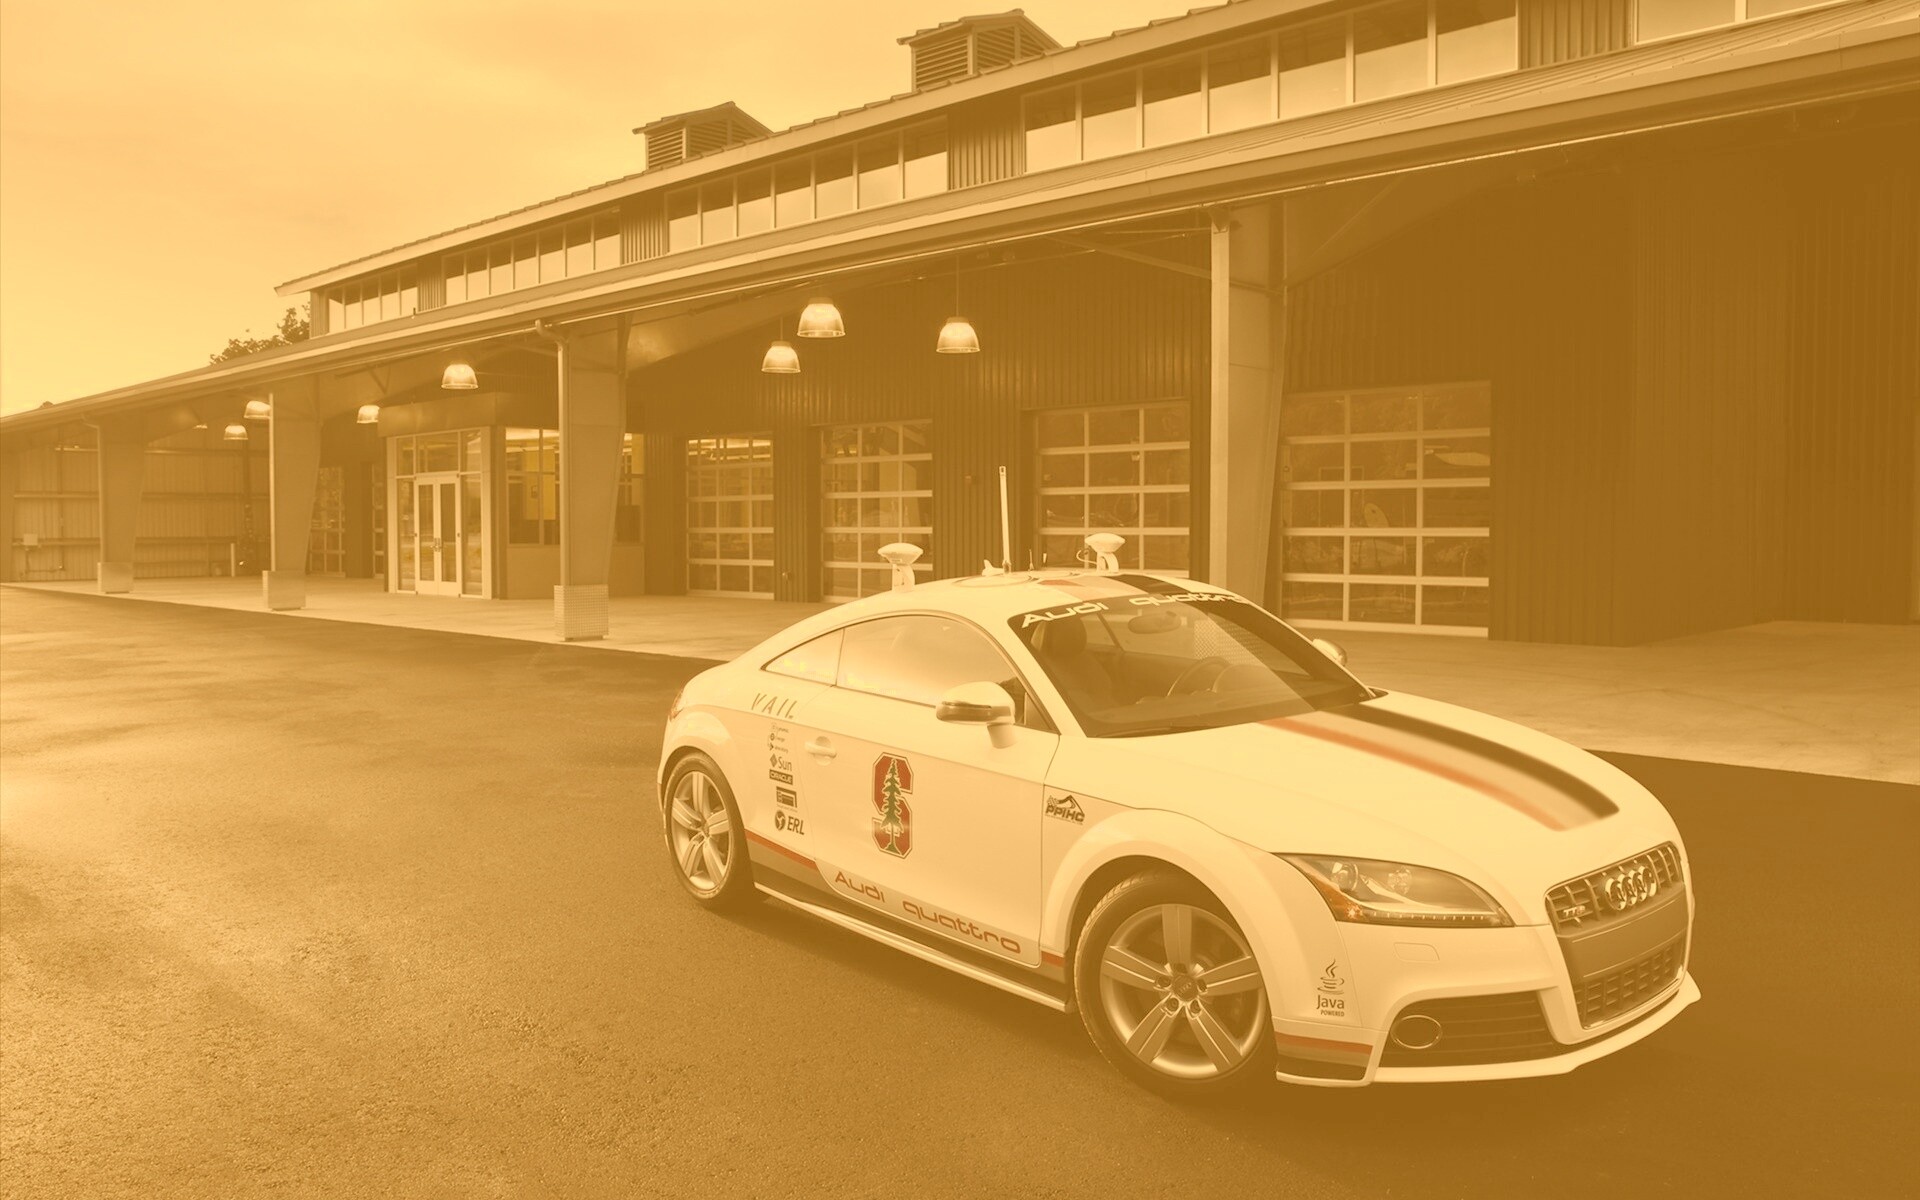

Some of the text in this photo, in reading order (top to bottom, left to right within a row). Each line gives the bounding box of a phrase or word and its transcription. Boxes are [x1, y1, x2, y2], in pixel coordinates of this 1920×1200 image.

[751, 693, 798, 720] VAIL
[777, 756, 793, 772] Sun
[1045, 803, 1085, 822] PPIHC
[787, 815, 805, 836] ERL
[834, 871, 1021, 954] Audi quattro
[1316, 994, 1345, 1010] Java
[1320, 1009, 1345, 1017] POWERED
